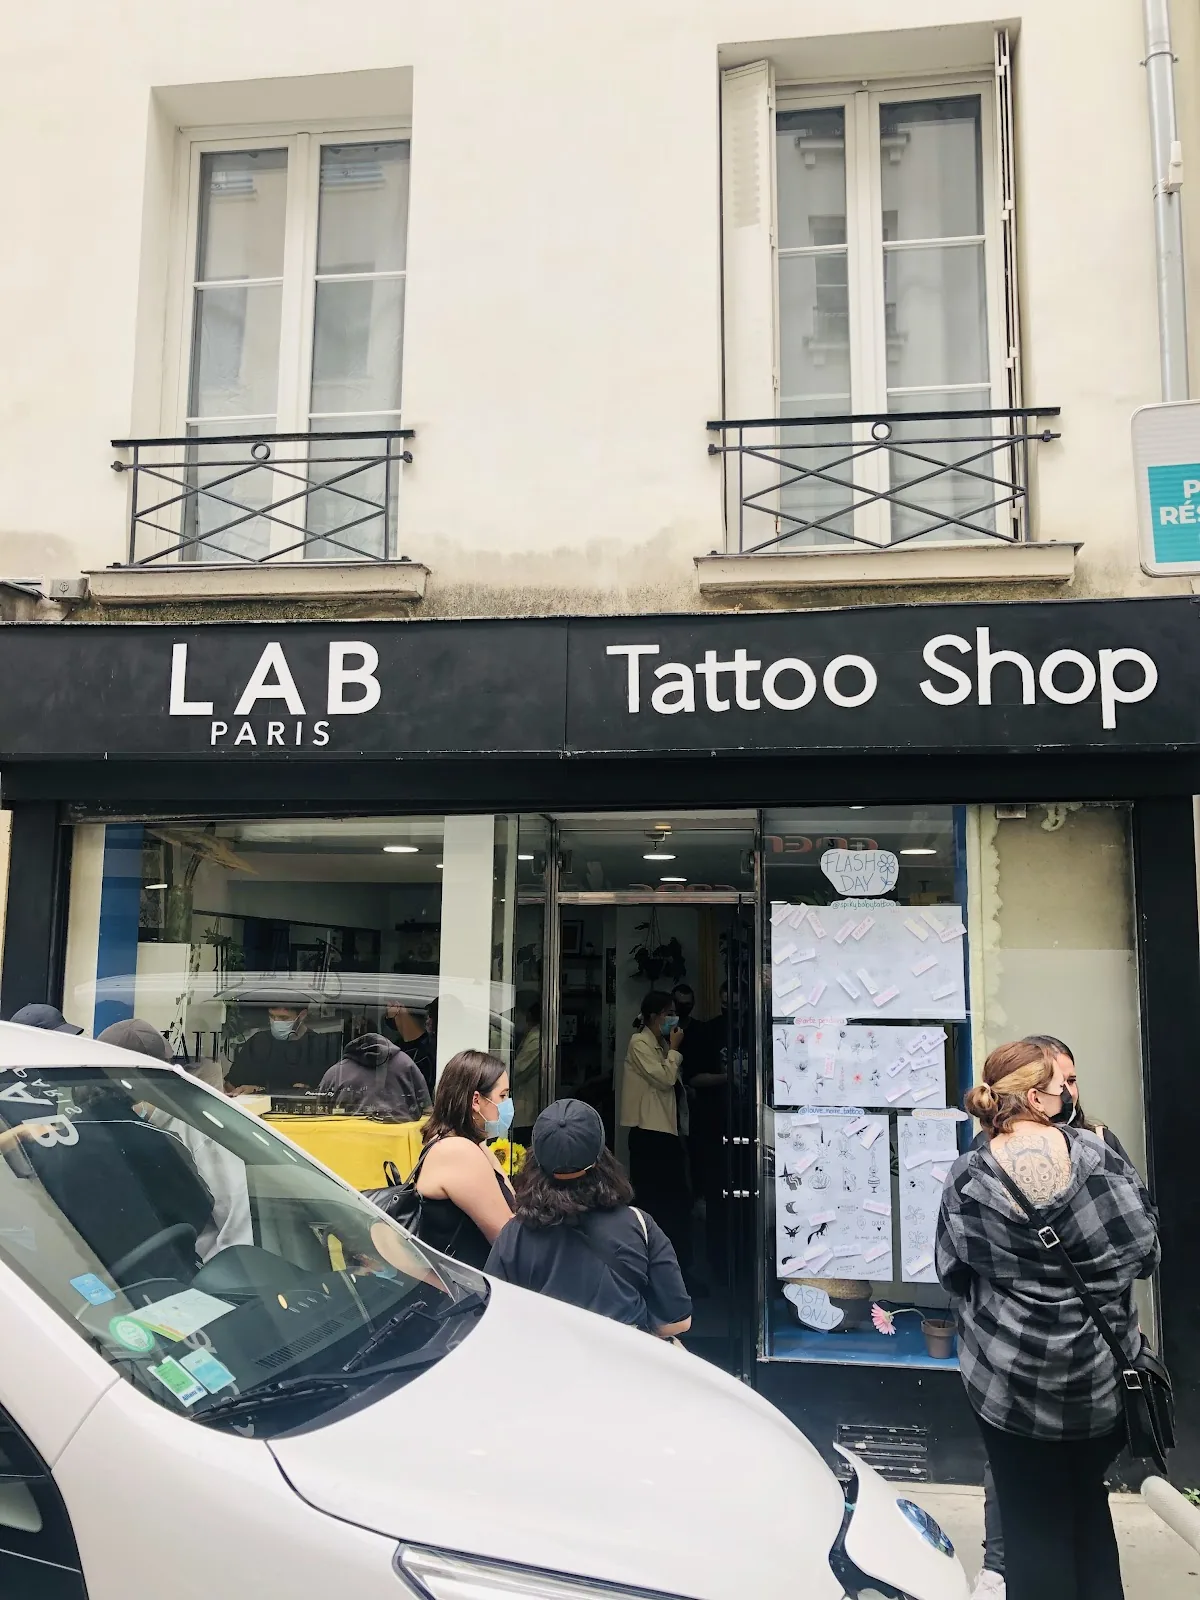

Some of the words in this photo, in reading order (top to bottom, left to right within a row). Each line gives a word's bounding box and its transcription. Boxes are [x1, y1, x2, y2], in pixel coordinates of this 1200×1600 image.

[1159, 500, 1200, 525] RÉ
[169, 640, 382, 716] LAB
[606, 644, 878, 715] Tattoo
[919, 626, 1158, 729] Shop
[210, 720, 331, 746] PARIS
[824, 852, 876, 872] FLASH
[840, 873, 874, 892] DAY
[786, 1284, 826, 1306] CASH
[800, 1305, 842, 1326] ONLY
